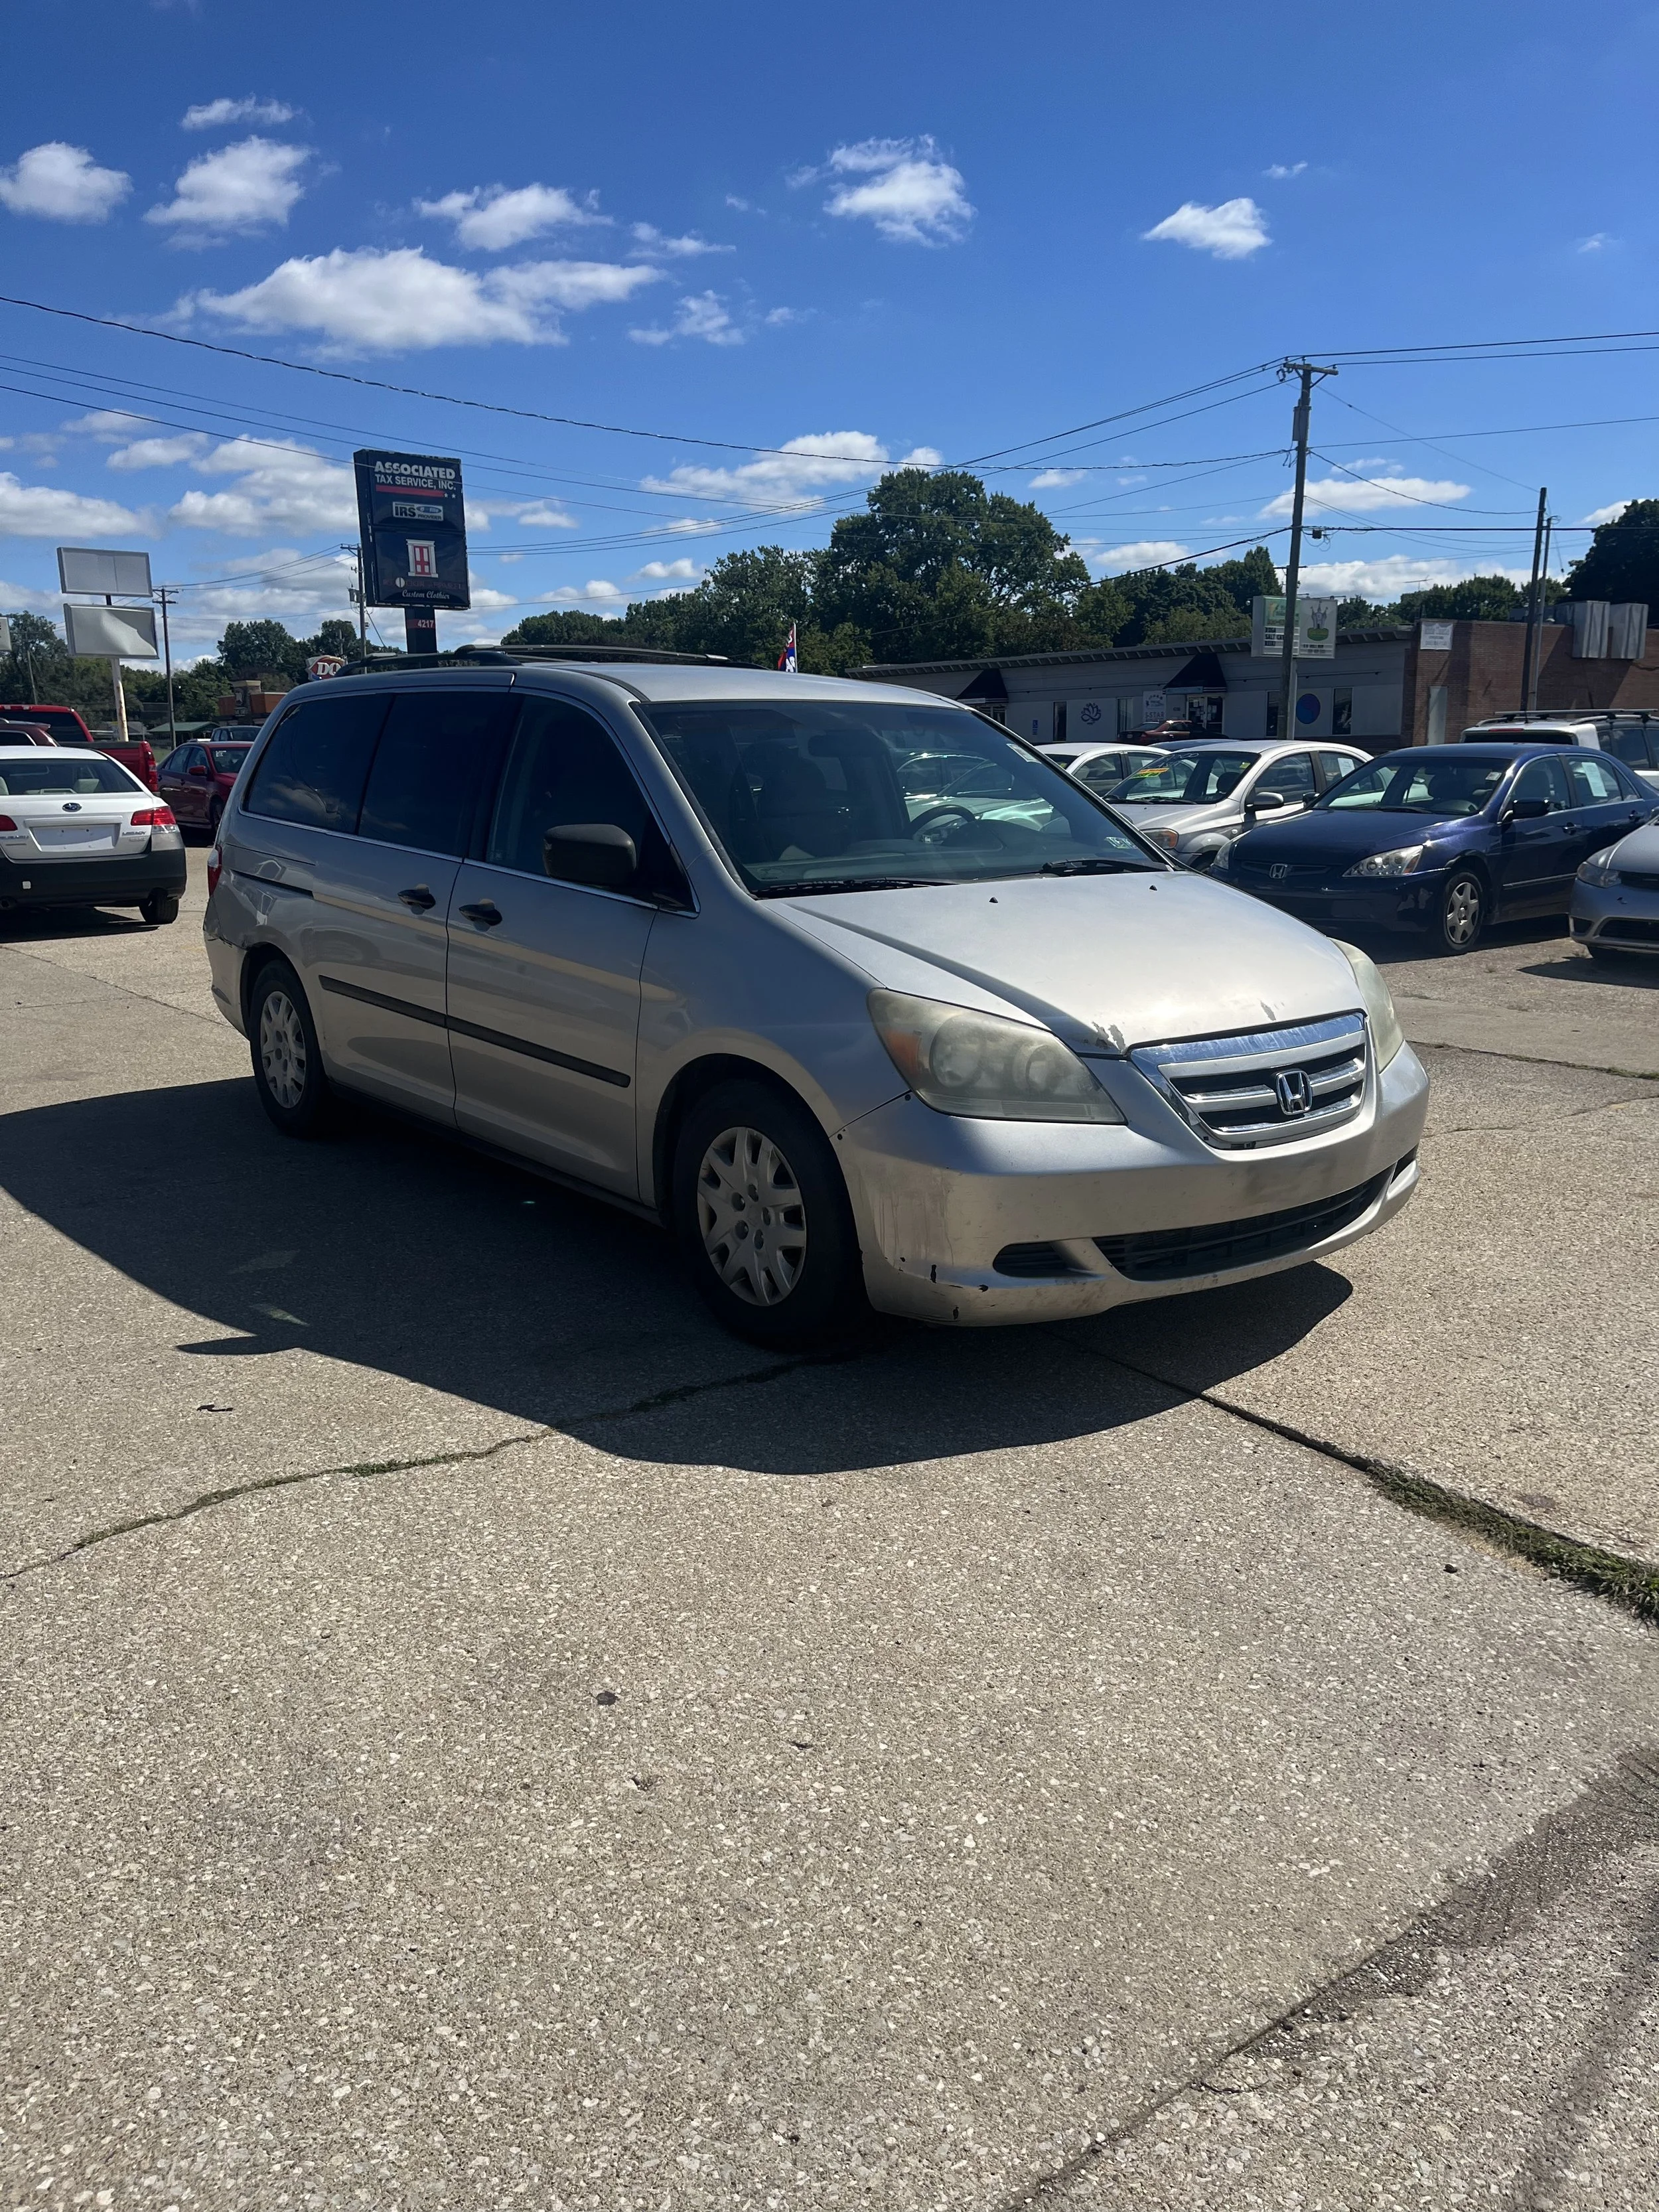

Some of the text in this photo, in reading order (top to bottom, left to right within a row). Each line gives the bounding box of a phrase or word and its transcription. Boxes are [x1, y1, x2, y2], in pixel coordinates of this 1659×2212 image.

[374, 461, 456, 479] ASSOCIATED
[375, 474, 456, 490] TAX SERVICE, INC.
[395, 506, 416, 517] IRS
[427, 591, 450, 599] Clothier
